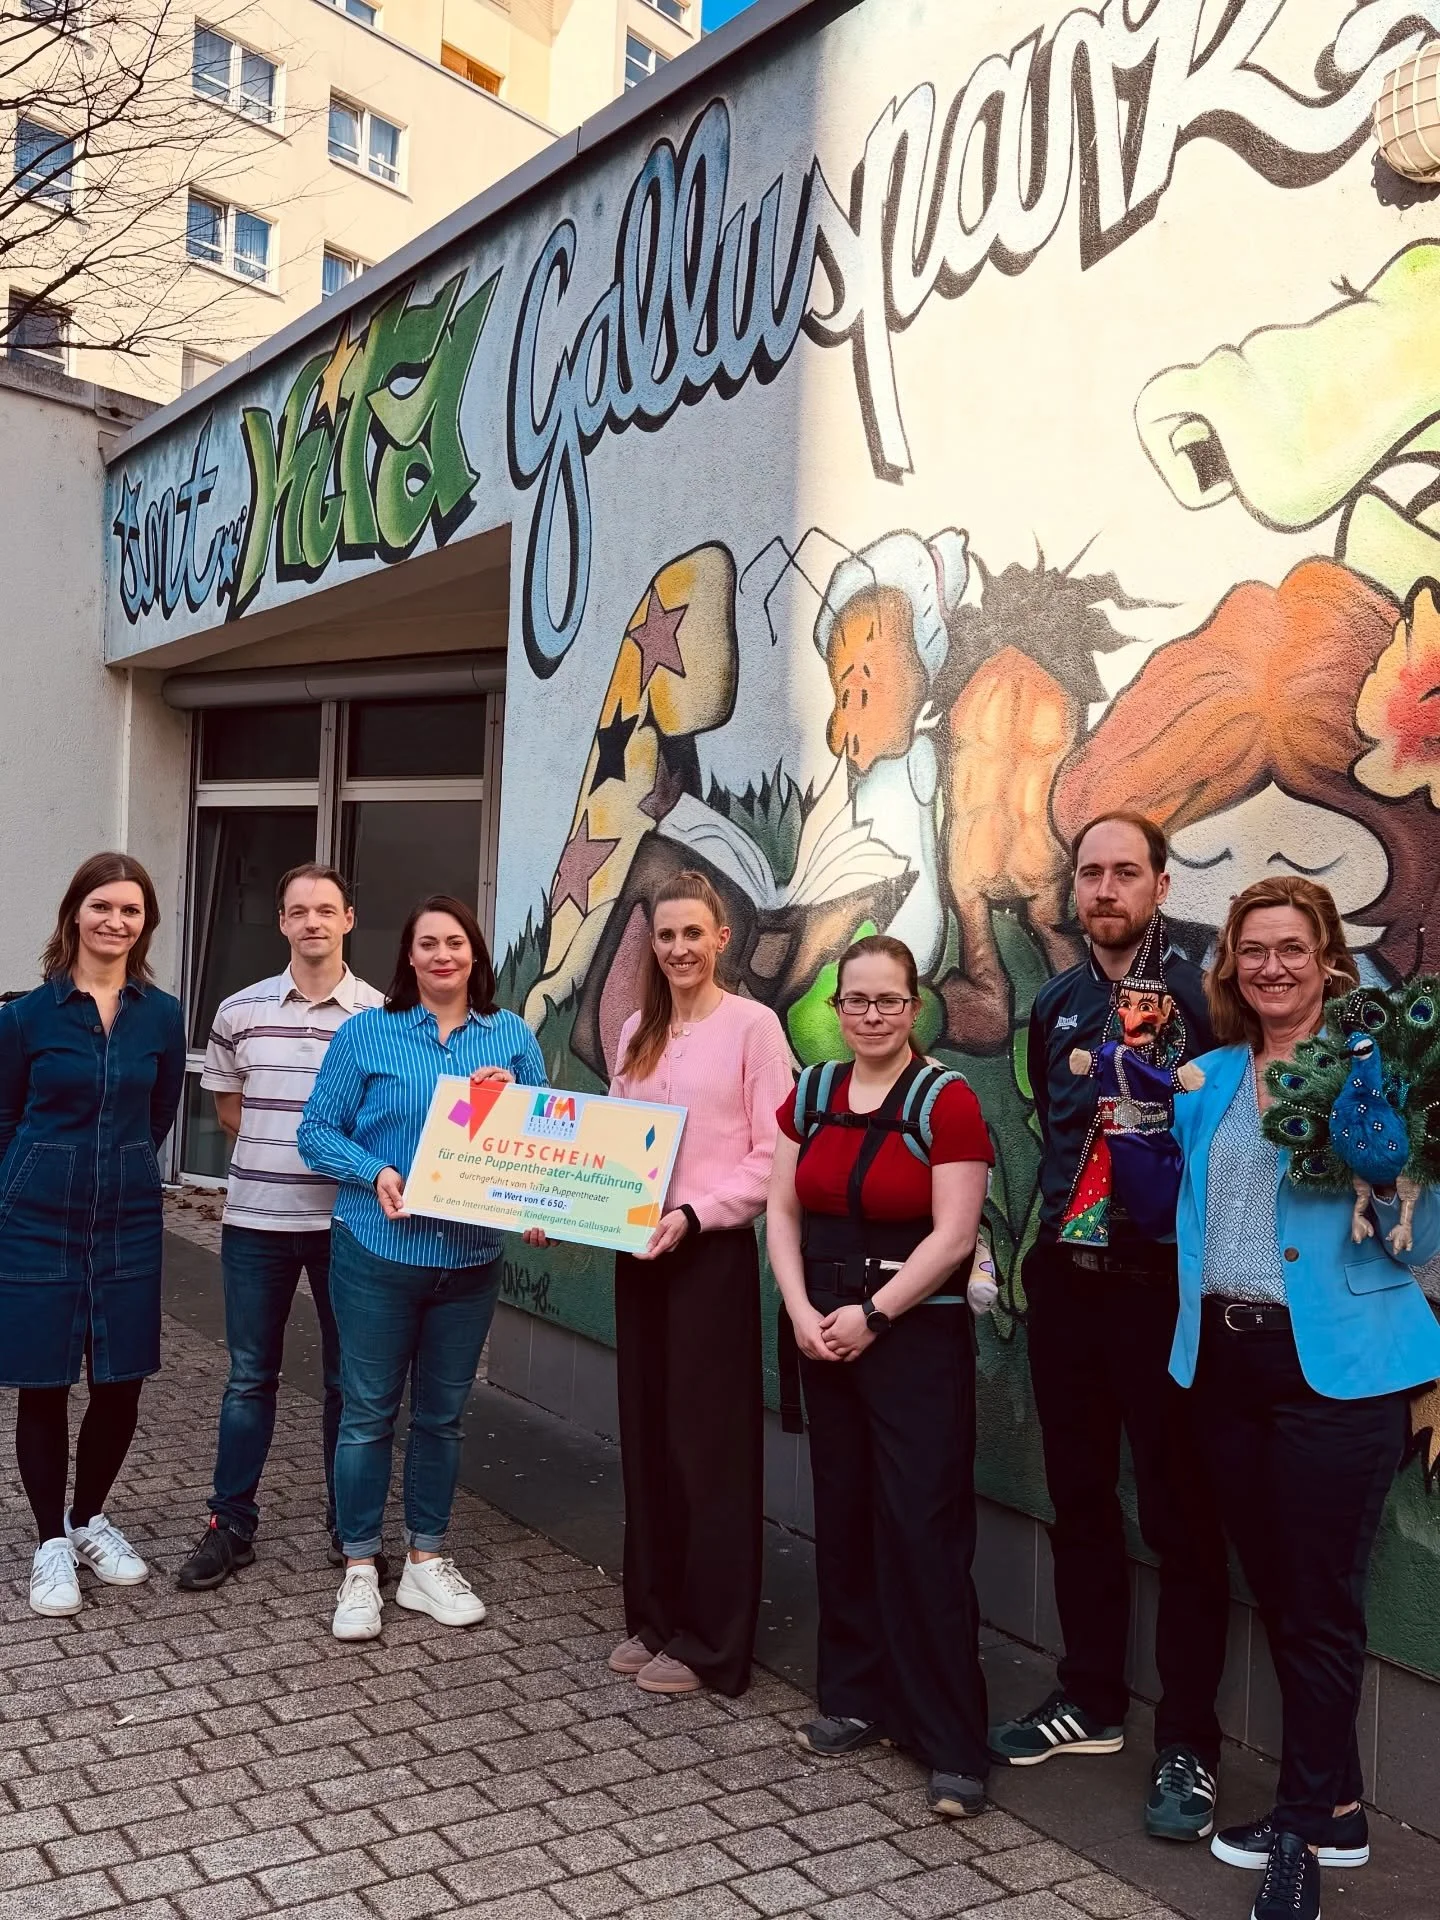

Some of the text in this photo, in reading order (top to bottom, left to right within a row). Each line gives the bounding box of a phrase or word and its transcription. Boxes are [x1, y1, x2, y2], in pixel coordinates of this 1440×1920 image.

[482, 1137, 606, 1169] GUTSCHEIN
[438, 1147, 643, 1193] für eine Puppentheater-Aufführung
[459, 1171, 509, 1186] durchgeführt
[511, 1181, 527, 1189] vom
[551, 1186, 610, 1203] Puppentheater
[492, 1189, 502, 1198] im
[504, 1191, 522, 1202] Wert
[524, 1196, 538, 1205] von
[540, 1197, 546, 1206] €
[433, 1194, 622, 1234] für den Internationalen Kindergarten Galluspark
